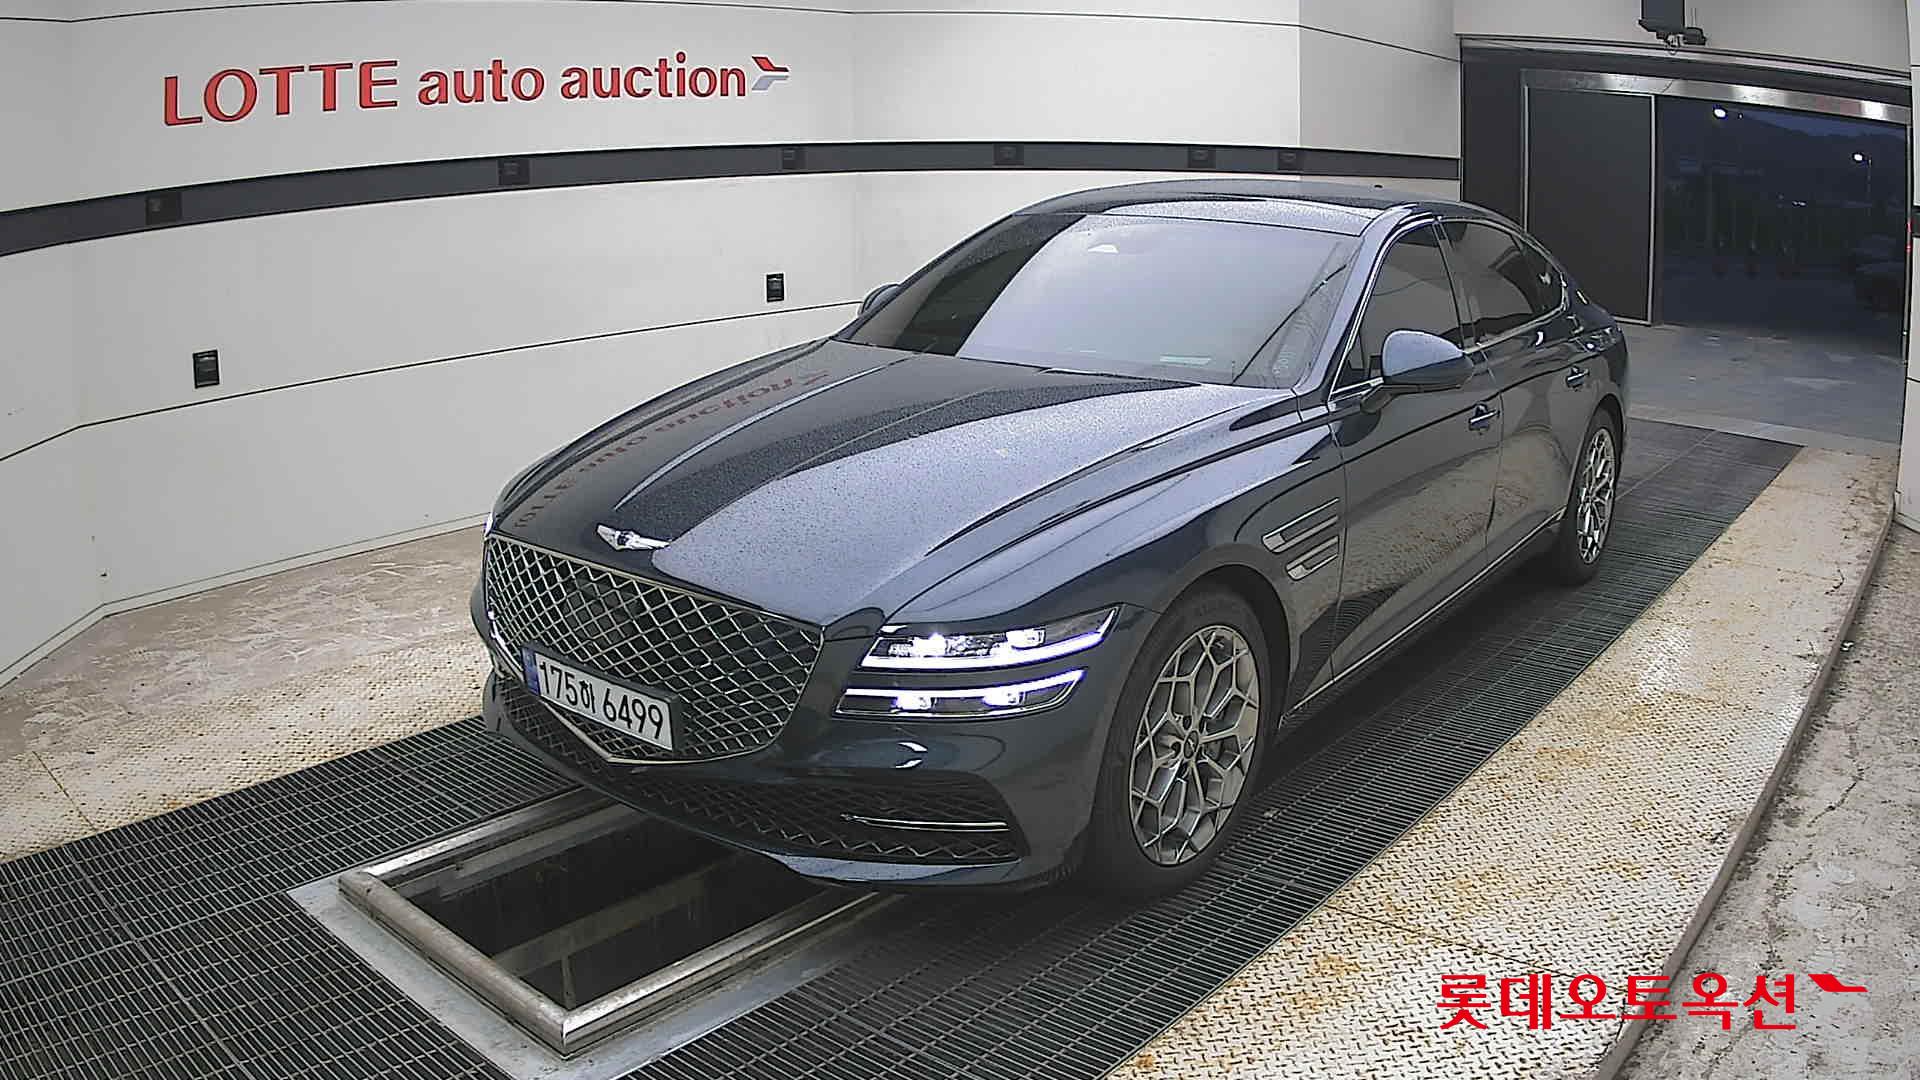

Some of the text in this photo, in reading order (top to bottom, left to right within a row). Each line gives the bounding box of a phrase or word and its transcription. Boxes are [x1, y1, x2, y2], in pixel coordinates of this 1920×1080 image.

[165, 52, 746, 126] LOTTE auto auction
[603, 688, 664, 740] 6499
